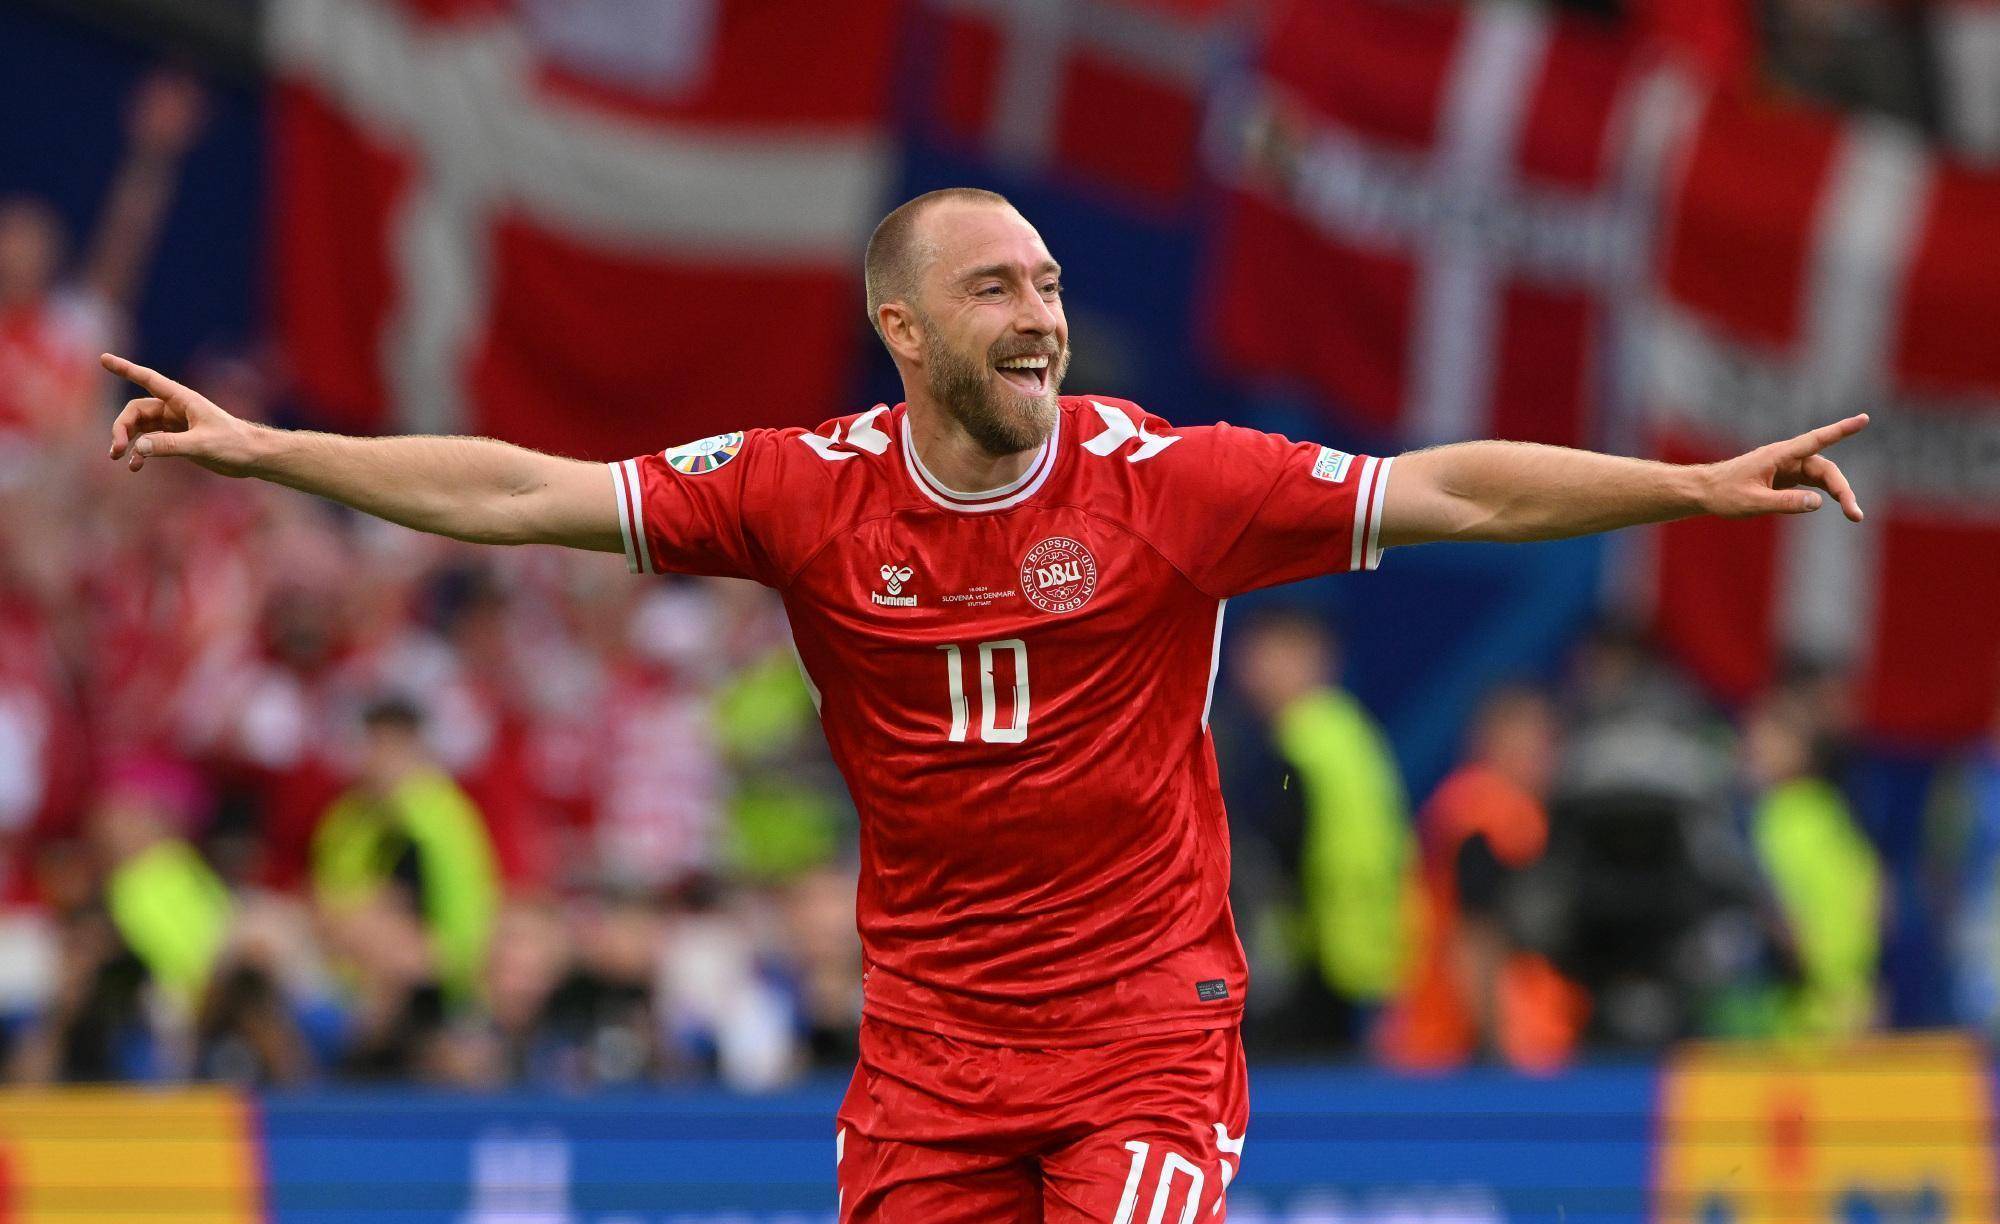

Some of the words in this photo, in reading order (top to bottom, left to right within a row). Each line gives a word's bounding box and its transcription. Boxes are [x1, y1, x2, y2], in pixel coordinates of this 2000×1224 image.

[1023, 566, 1047, 608] DANSK
[1035, 560, 1082, 588] DBU
[1081, 555, 1095, 596] UNION
[871, 590, 918, 607] hummel
[942, 594, 974, 602] SLOVENIA
[983, 590, 1016, 600] DENMARK
[1052, 597, 1081, 611] 1889
[936, 638, 1030, 743] 10
[1112, 1140, 1205, 1224] 10
